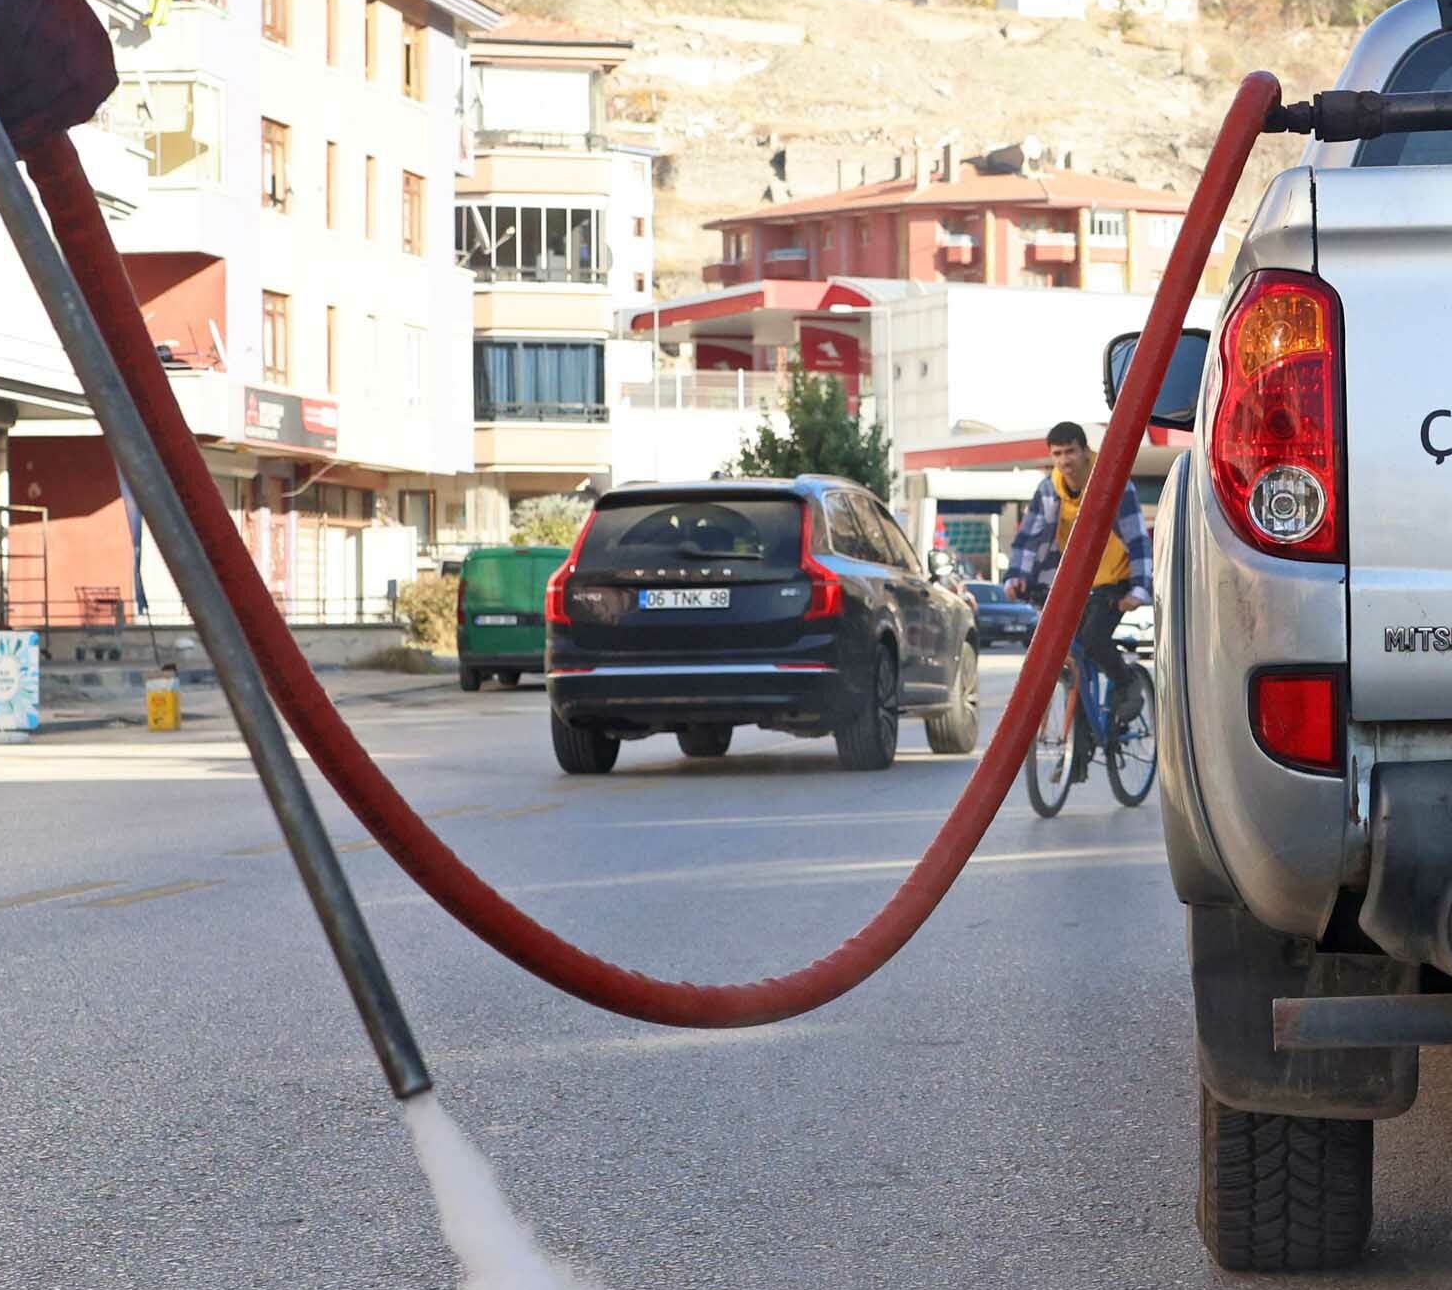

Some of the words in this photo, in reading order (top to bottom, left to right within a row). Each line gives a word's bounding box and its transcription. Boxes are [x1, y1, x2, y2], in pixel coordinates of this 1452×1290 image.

[647, 589, 665, 606] 06
[672, 589, 702, 606] TNK
[709, 589, 729, 606] 98
